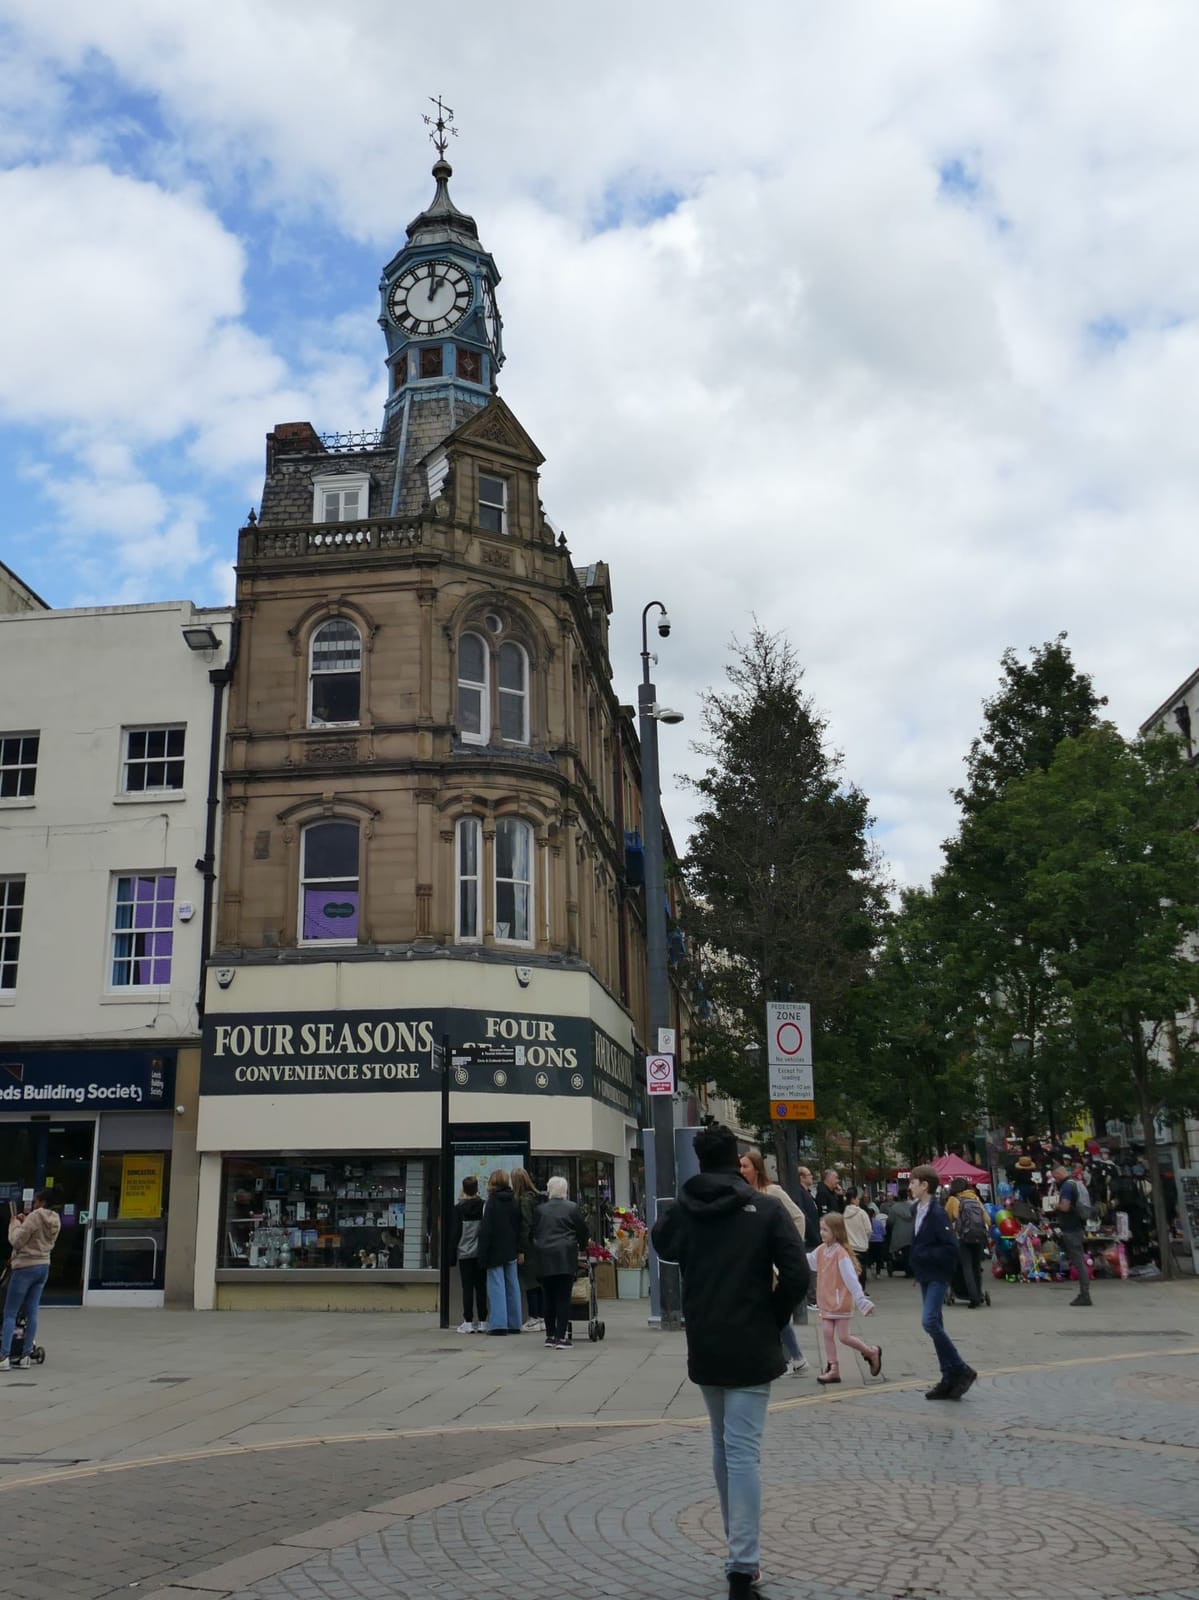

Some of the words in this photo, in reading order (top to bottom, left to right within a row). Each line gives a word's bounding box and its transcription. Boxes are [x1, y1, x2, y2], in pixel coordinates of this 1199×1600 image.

[776, 1011, 801, 1020] ZONE
[214, 1024, 295, 1056] FOUR
[300, 1021, 433, 1055] SEASONS
[485, 1017, 556, 1041] FOUR
[235, 1064, 359, 1082] CONVENIENCE
[361, 1063, 420, 1080] STORE
[24, 1084, 85, 1103] Building
[87, 1083, 143, 1102] Society
